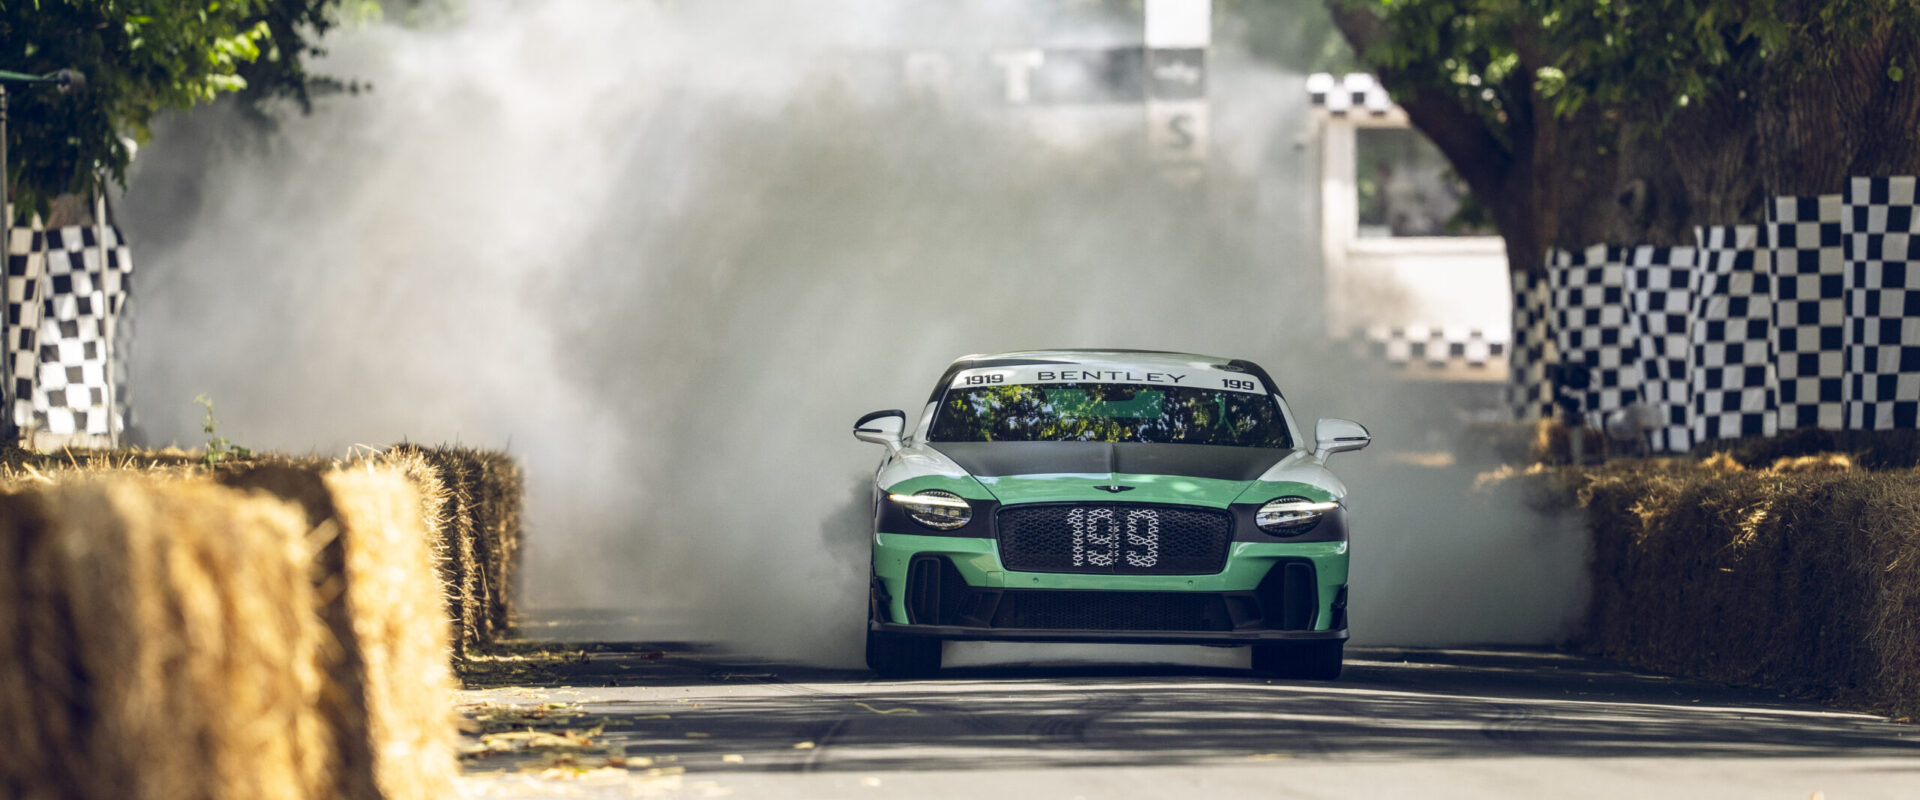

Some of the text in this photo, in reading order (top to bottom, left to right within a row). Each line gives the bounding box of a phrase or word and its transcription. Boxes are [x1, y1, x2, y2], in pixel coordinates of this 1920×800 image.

[965, 371, 1255, 391] 1919 BENTLEY 199
[1067, 508, 1160, 567] 199
